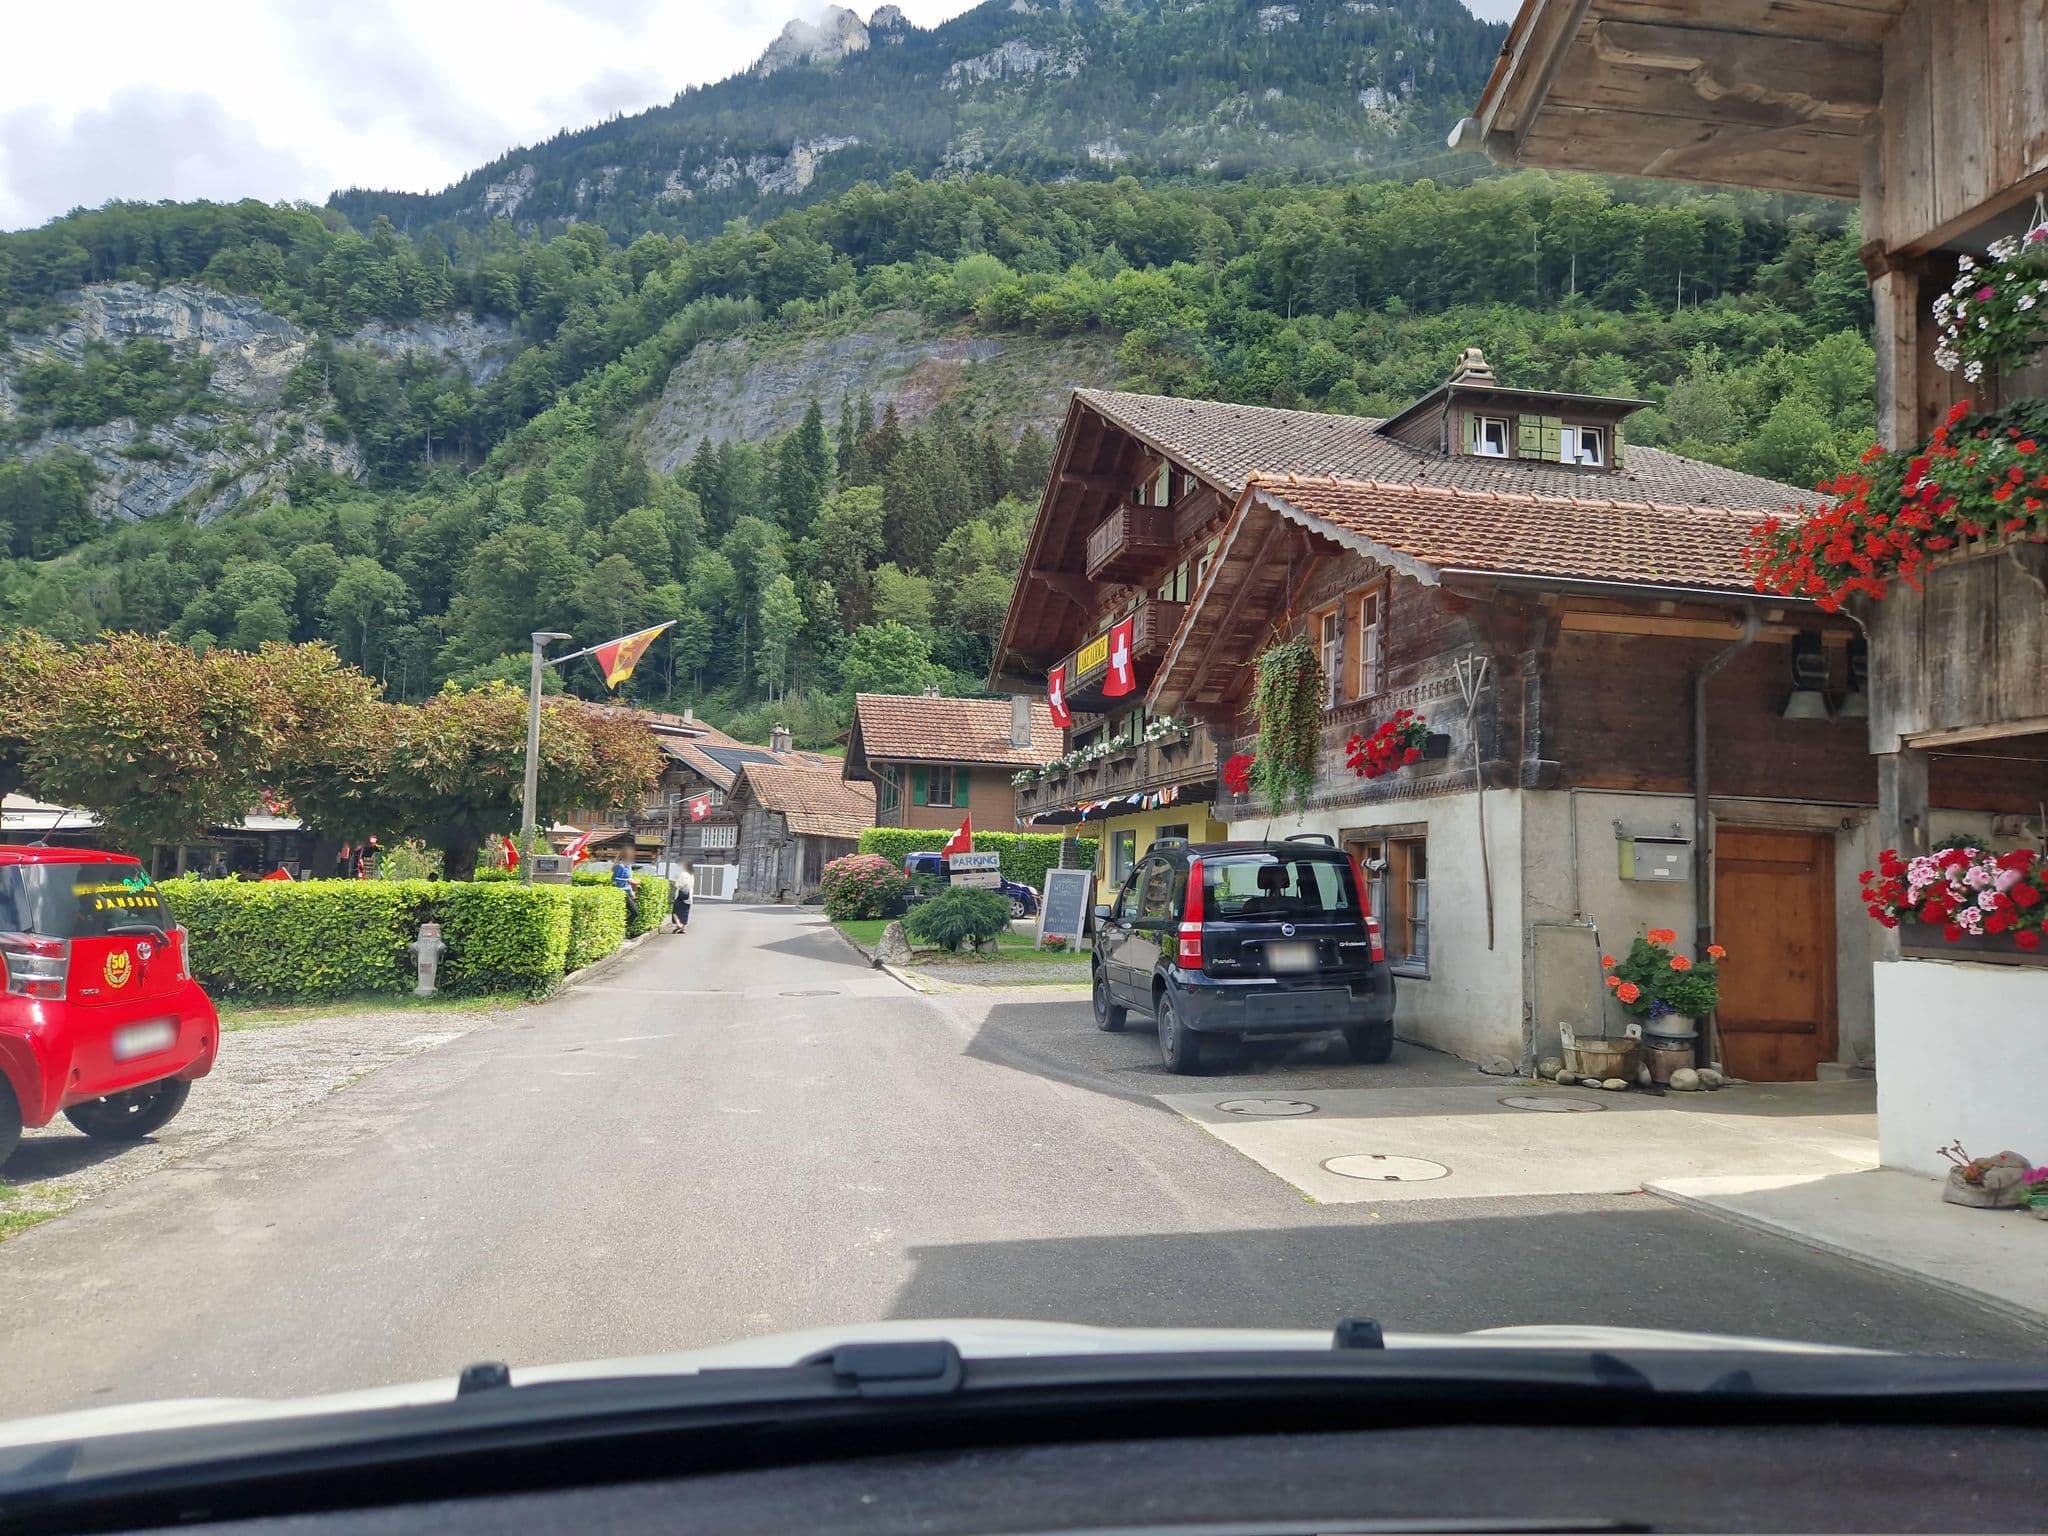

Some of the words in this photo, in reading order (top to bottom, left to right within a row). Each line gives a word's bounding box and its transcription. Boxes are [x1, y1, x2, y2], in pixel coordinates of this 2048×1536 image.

[952, 855, 997, 866] PARKING
[95, 897, 158, 910] JANSSEN
[111, 954, 125, 969] 50
